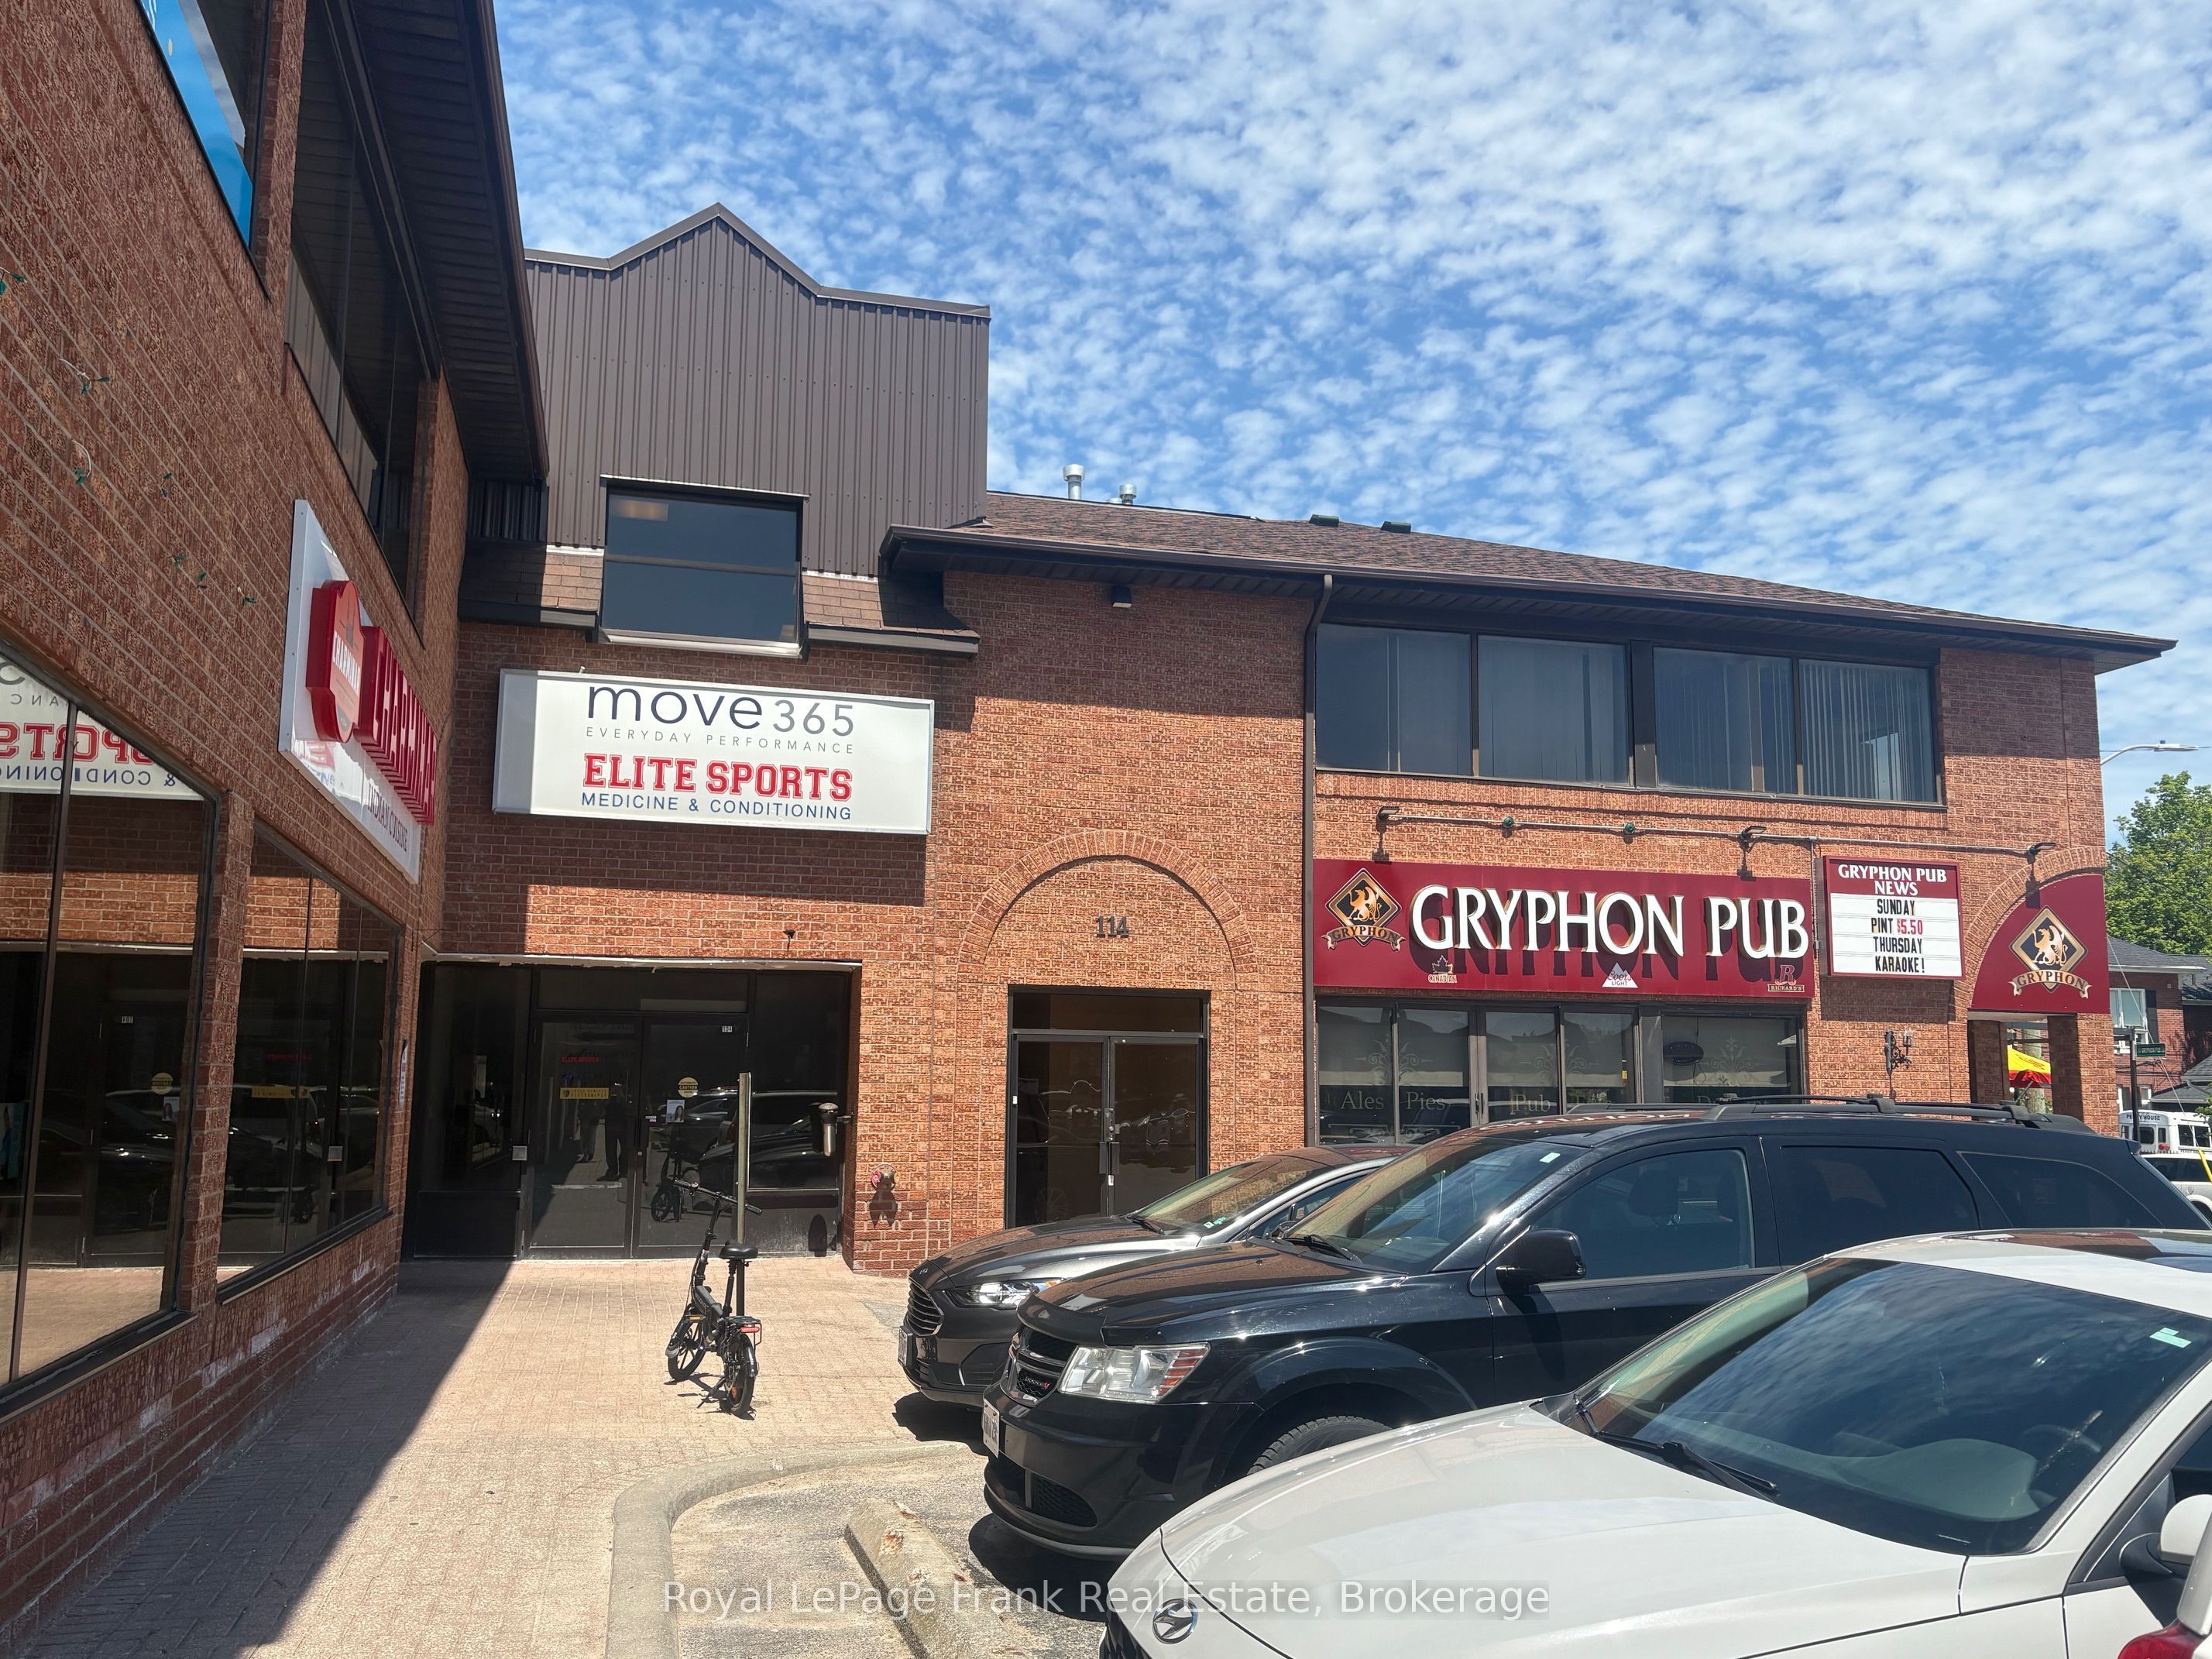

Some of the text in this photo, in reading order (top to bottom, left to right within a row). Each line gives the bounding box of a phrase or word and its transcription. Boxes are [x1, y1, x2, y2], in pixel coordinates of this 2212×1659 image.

[373, 628, 437, 823] CHARMINAR
[586, 726, 854, 754] EVERYDAY PERFORMANCE
[582, 753, 854, 801] ELITE SPORTS
[582, 792, 852, 821] MEDICINE & CONDITIONING
[368, 783, 408, 853] INDIAN CUISINE
[1838, 864, 1948, 883] GRYPHON PUB
[1874, 881, 1918, 896] NEWS
[1877, 899, 1915, 916] SUNDAY
[1096, 915, 1129, 937] 114
[1412, 884, 1809, 960] GRYPHON PUB
[1870, 918, 1923, 936] PINT $5.50
[1331, 925, 1398, 942] GRYPHON
[1873, 936, 1922, 954] THURSDAY
[1875, 956, 1925, 974] KARAOKE!
[1427, 974, 1458, 984] CANADIAN
[1608, 970, 1632, 981] Coors
[2017, 970, 2087, 990] GRYPHON
[1341, 1091, 1446, 1111] Ales Pies
[1515, 1094, 1551, 1112] Pub
